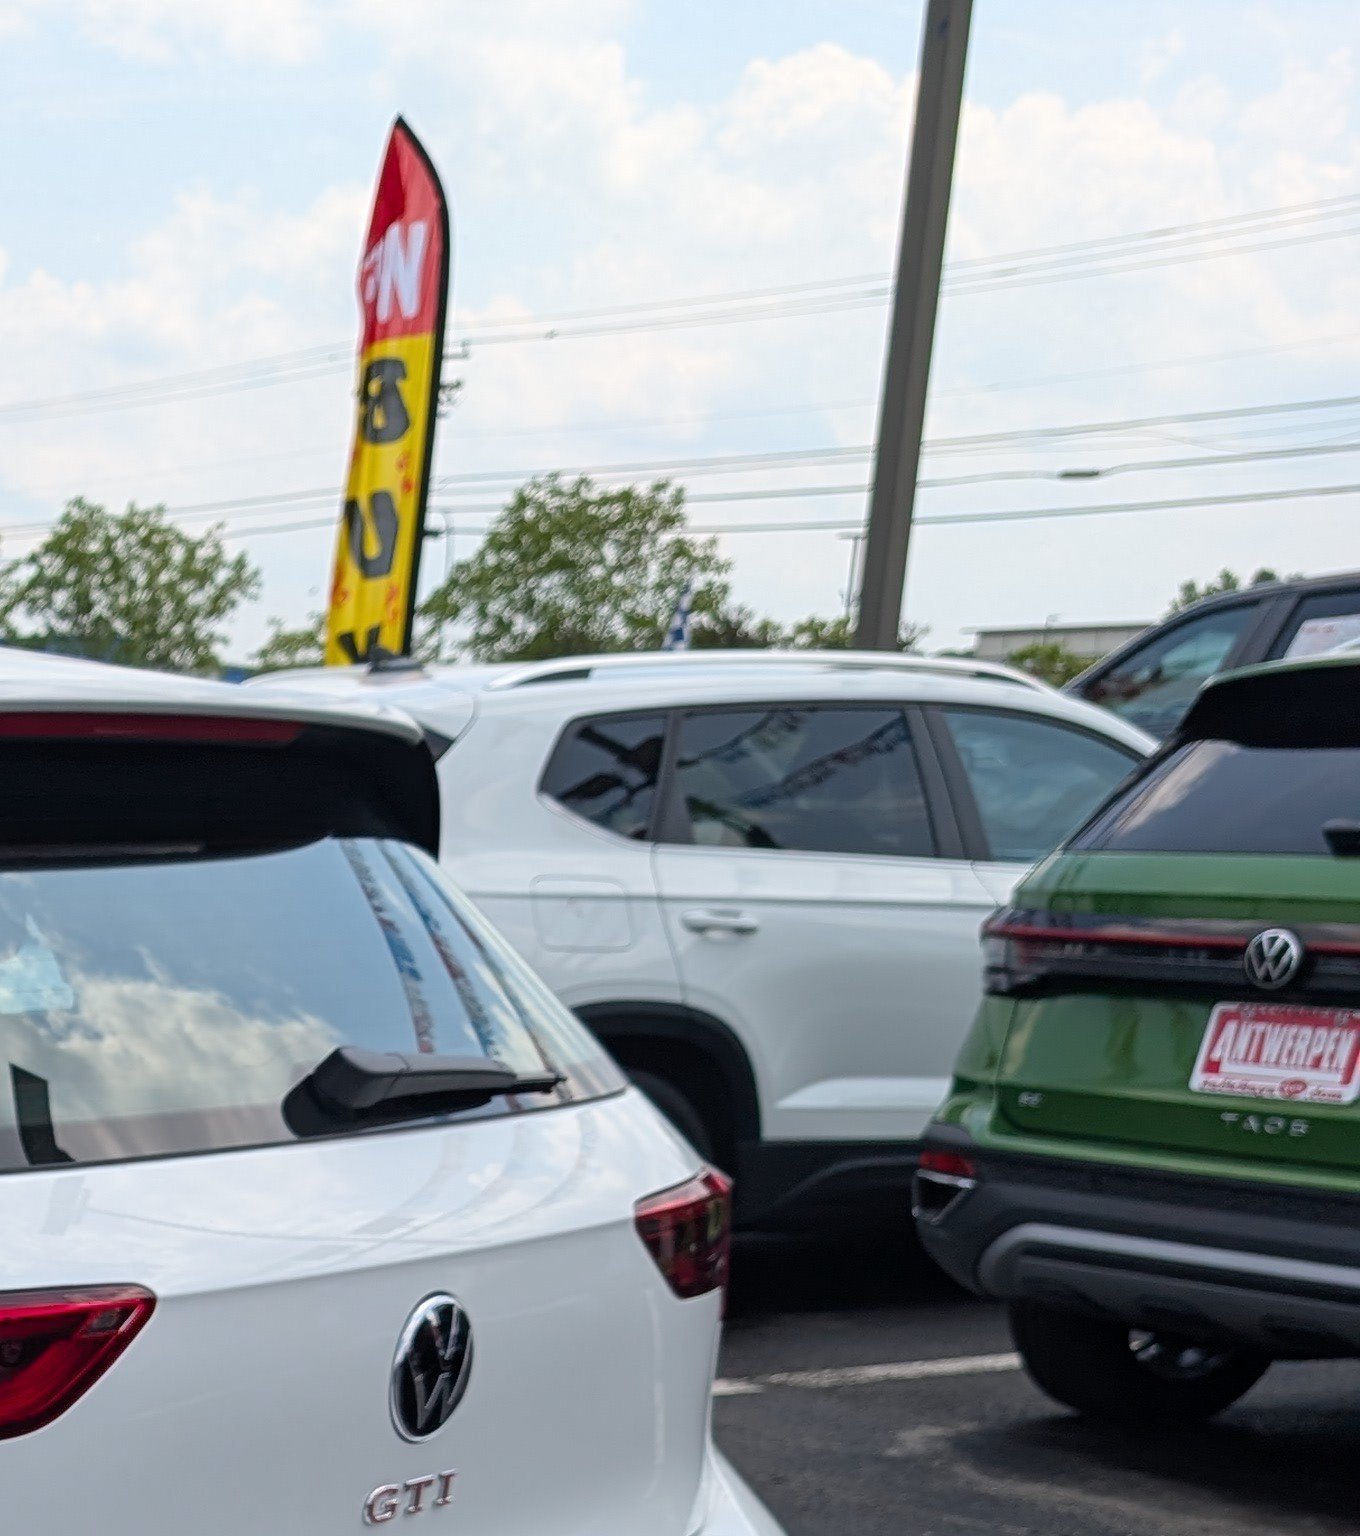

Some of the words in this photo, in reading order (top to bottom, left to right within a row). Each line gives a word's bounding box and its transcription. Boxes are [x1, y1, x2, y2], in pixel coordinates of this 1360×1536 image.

[1209, 1019, 1356, 1074] ANTWERPEN
[1220, 1111, 1310, 1137] TAOS
[363, 1468, 458, 1524] GTI
